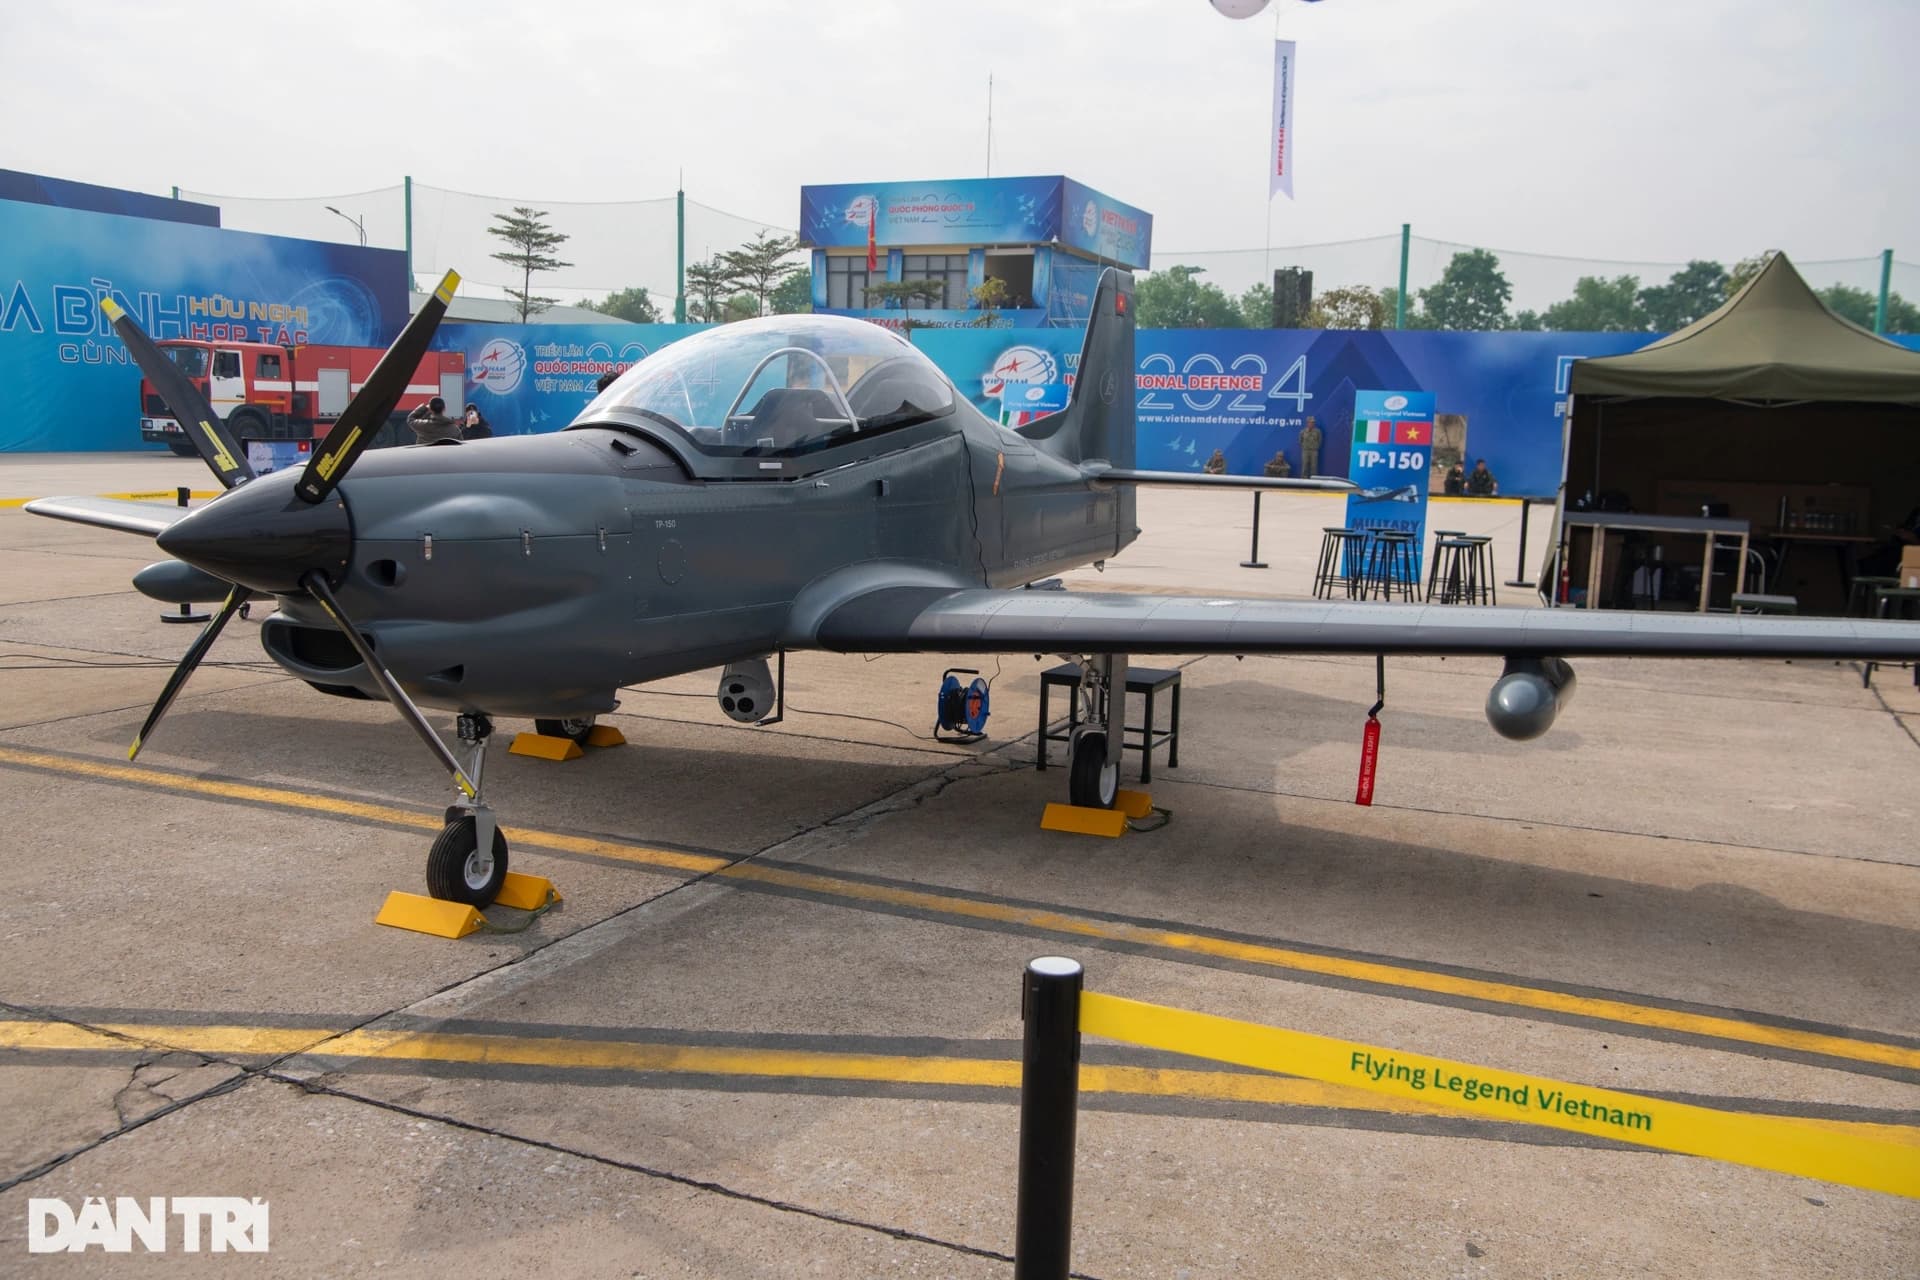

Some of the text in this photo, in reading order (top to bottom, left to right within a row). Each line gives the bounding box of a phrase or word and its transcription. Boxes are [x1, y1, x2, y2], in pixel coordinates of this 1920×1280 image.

[258, 323, 309, 345] TÁC
[59, 339, 138, 365] CÙN
[534, 357, 569, 374] QUỐC
[570, 357, 614, 374] PHÒNG
[559, 379, 584, 392] NAM
[1137, 353, 1314, 413] 2024
[1188, 375, 1263, 391] DEFENCE
[1138, 414, 1302, 427] www.vietnamdefence.vdi.org.vn
[1358, 450, 1424, 470] TP-150
[1351, 1051, 1652, 1131] Flying Legend Vietnam
